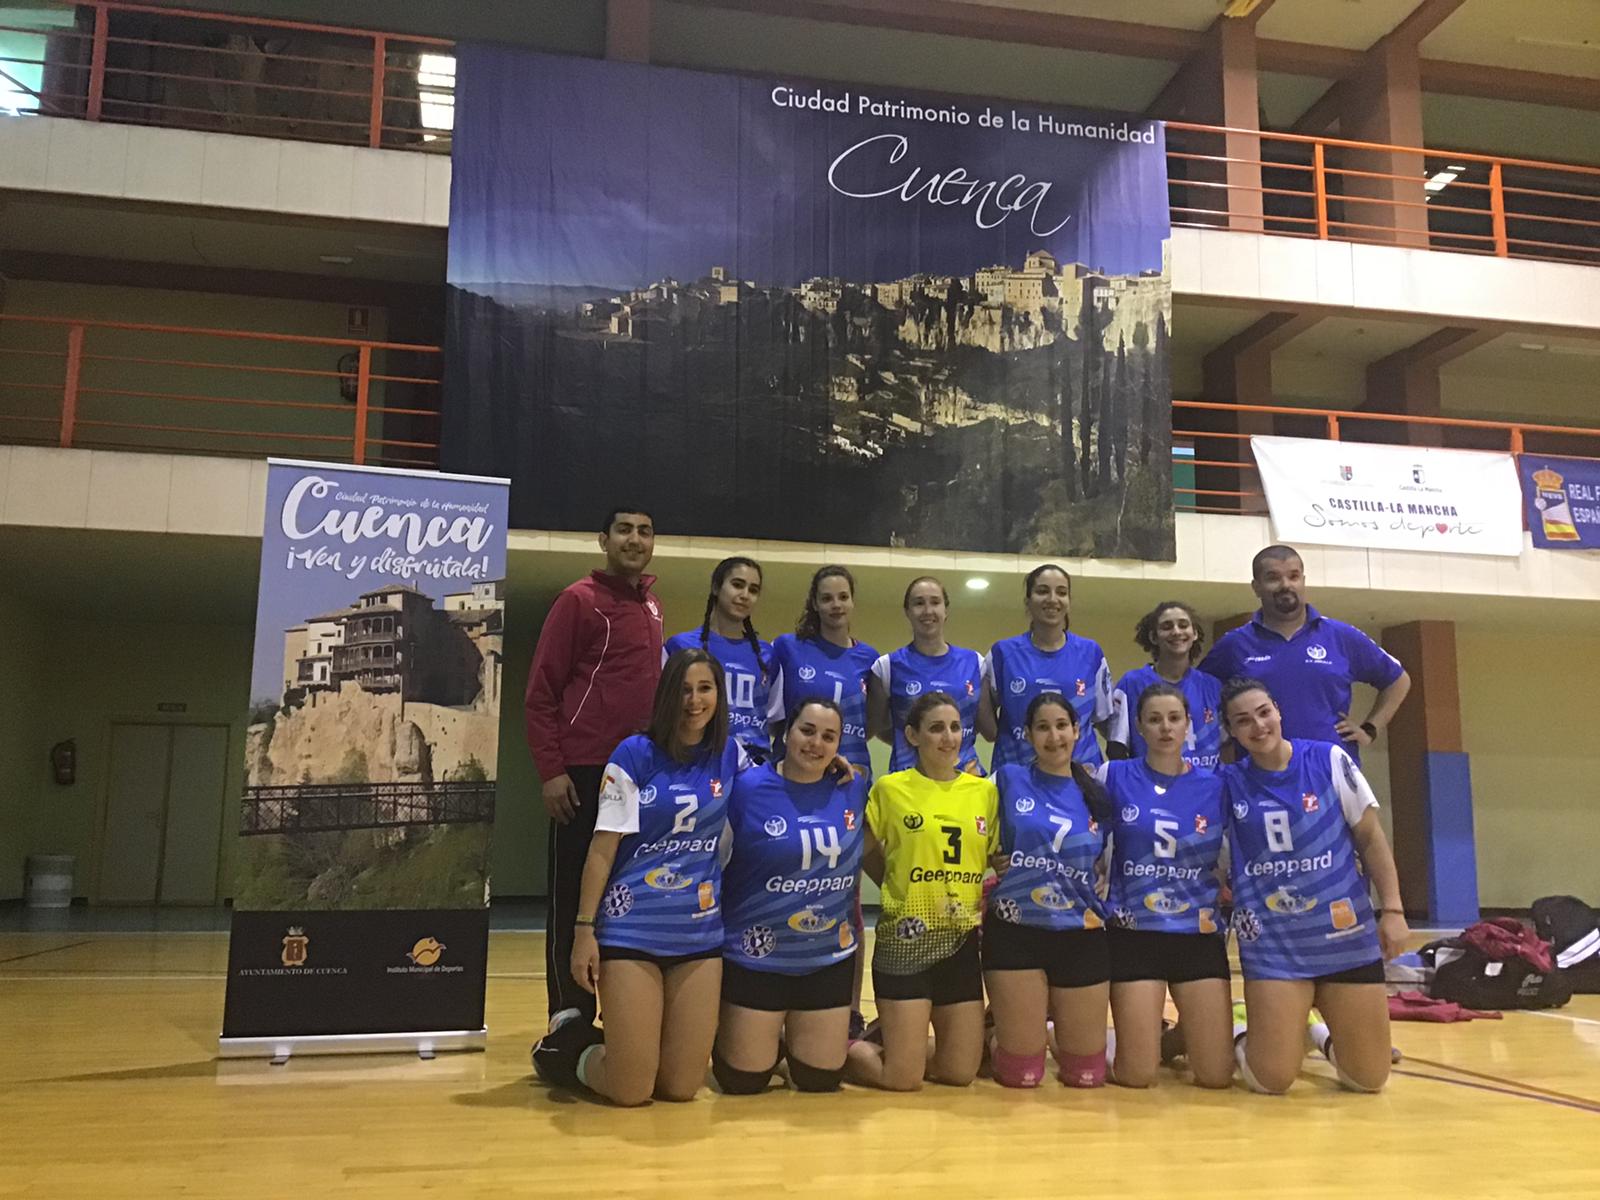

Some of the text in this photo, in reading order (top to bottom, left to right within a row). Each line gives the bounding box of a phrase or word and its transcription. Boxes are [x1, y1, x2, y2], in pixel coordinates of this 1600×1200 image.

[771, 87, 1155, 144] Ciudad Patrimonio de la Humanidad
[828, 134, 1071, 237] Cuenca
[1329, 497, 1458, 517] CASTILLA-LA MANCHA
[1568, 484, 1594, 501] REAL
[281, 476, 495, 555] Cuenca
[1303, 503, 1379, 528] Somos
[346, 555, 367, 579] y
[725, 671, 755, 708] 10
[672, 794, 698, 834] 2
[1264, 810, 1294, 852] 8
[800, 826, 842, 870] 14
[941, 826, 961, 865] 3
[1049, 815, 1072, 853] 7
[1154, 819, 1179, 858] 5
